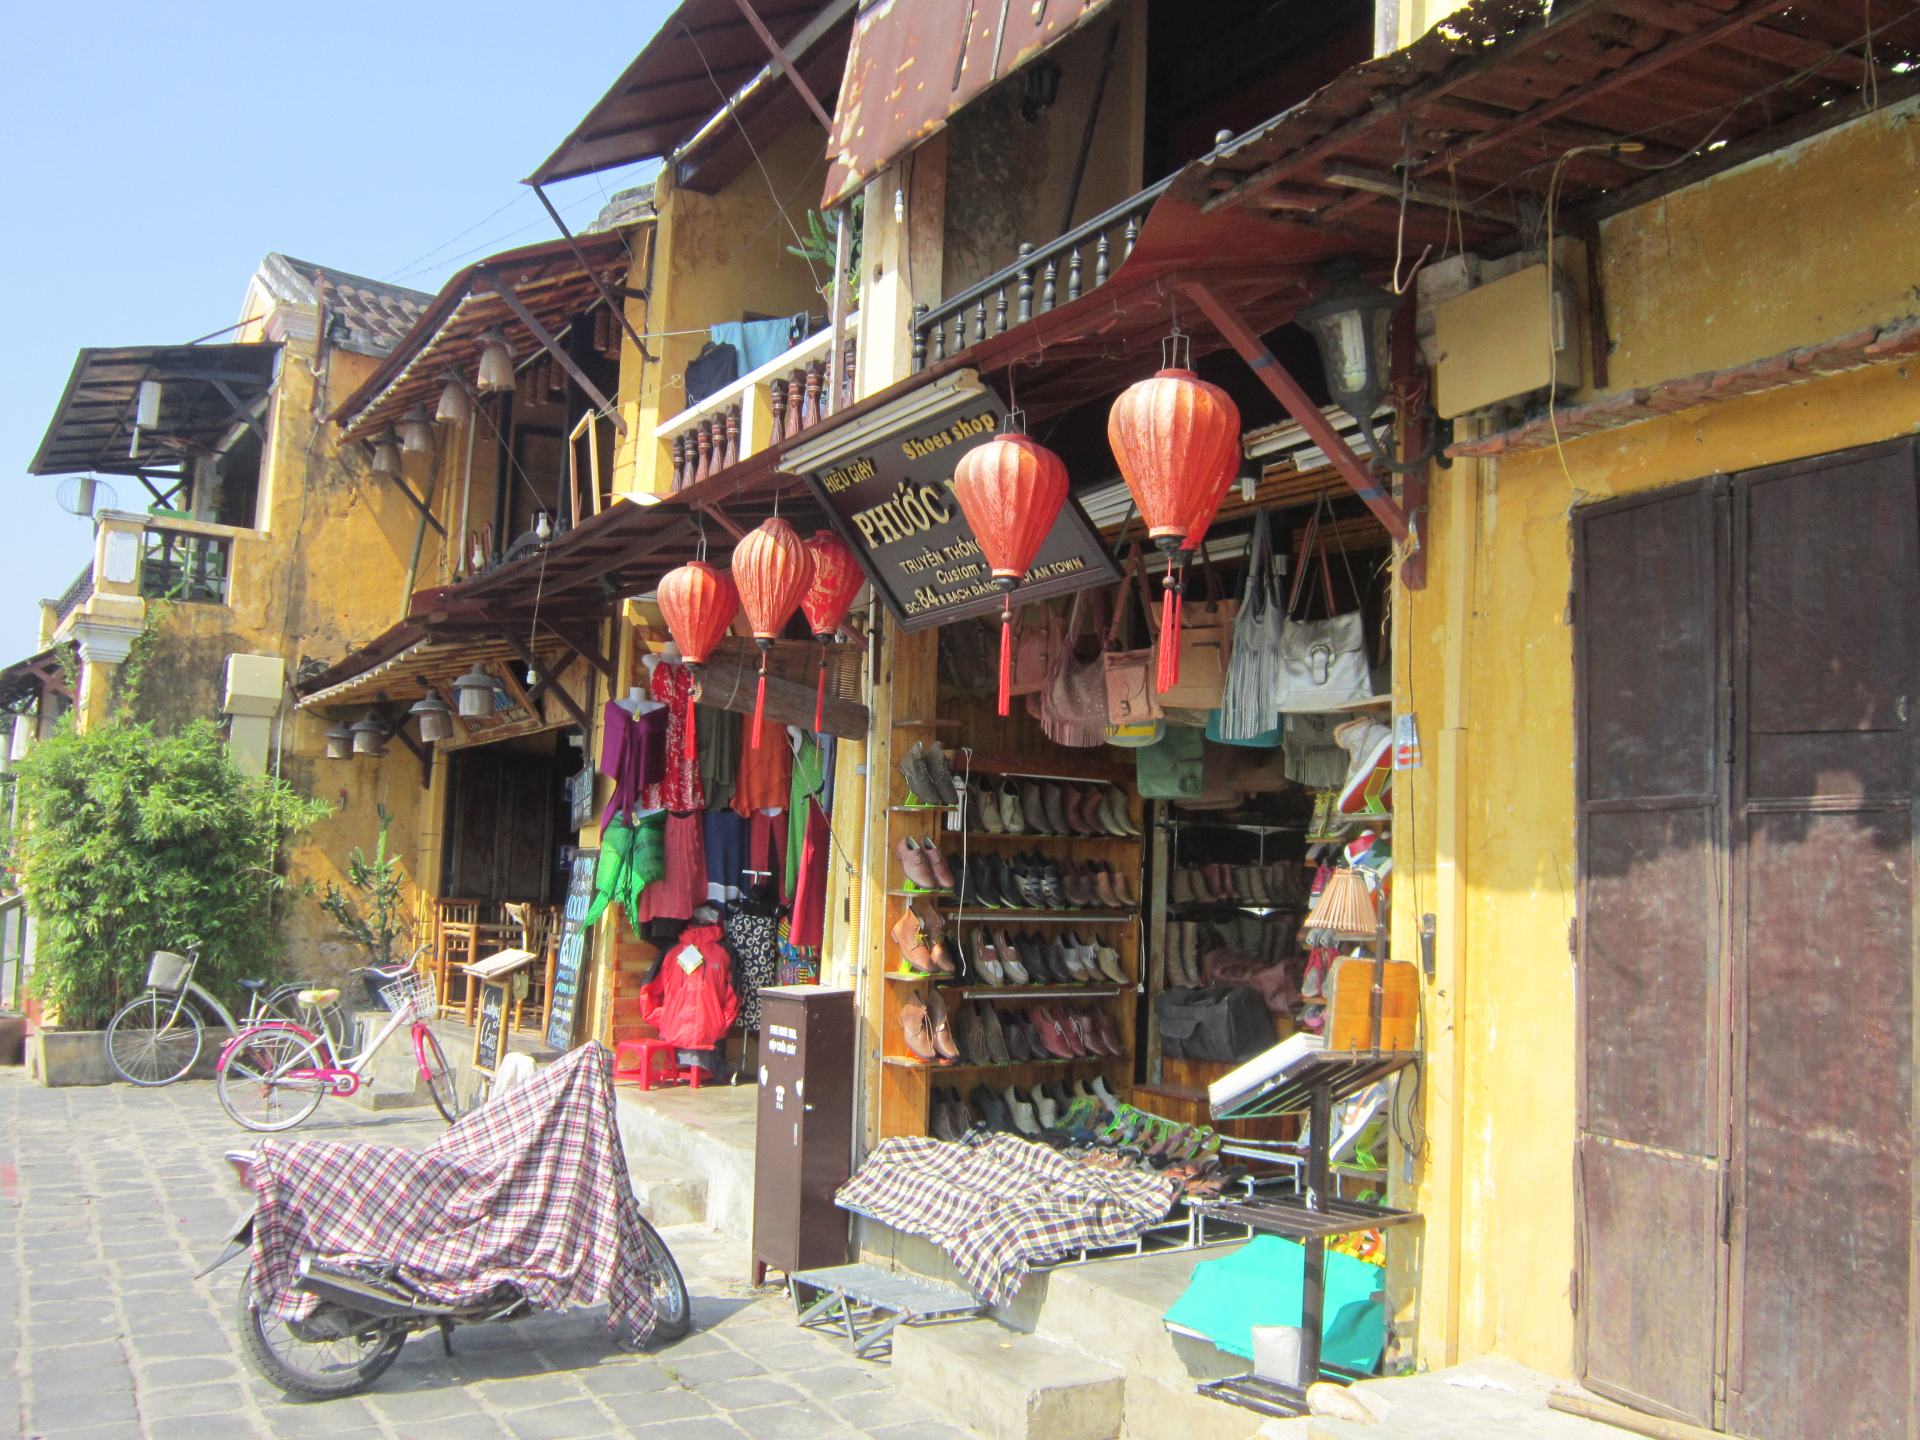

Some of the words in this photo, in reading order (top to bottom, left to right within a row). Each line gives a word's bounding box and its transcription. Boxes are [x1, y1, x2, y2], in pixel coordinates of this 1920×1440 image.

[901, 432, 953, 461] Shoes
[951, 412, 995, 441] shop
[852, 482, 950, 549] PHƯỚC
[936, 564, 980, 585] Custom
[1050, 557, 1084, 575] TOWN
